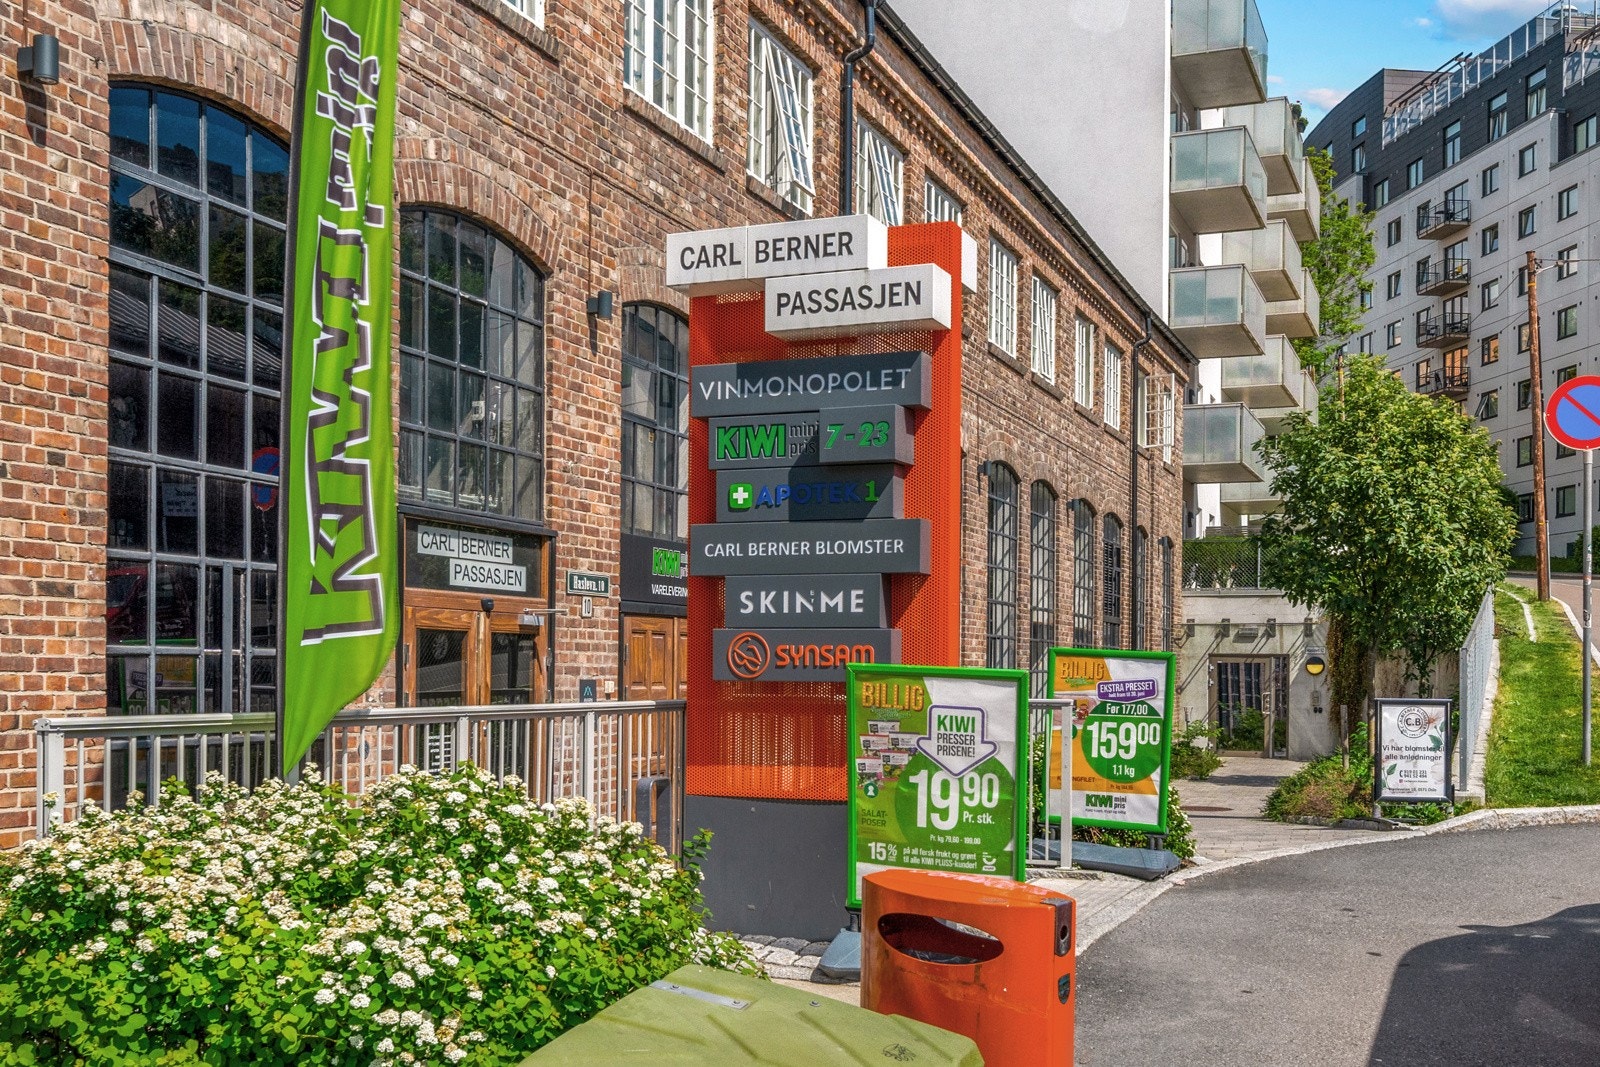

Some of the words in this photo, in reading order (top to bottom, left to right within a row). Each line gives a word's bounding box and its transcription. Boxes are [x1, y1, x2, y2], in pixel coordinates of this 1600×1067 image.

[680, 242, 741, 271] CARL
[755, 231, 854, 264] BERNER
[776, 280, 922, 317] PASSASJEN
[699, 368, 912, 401] VINMONOPOLET
[300, 214, 385, 646] KIWI
[788, 420, 819, 438] mini
[715, 422, 787, 461] KIWI
[788, 438, 816, 459] pris
[755, 482, 863, 508] APOTEK
[421, 531, 455, 552] CARL
[461, 537, 510, 560] BERNER
[704, 542, 743, 558] CARL
[749, 541, 810, 557] BERNER
[816, 538, 904, 556] BLOMSTER
[652, 546, 681, 578] KIWI
[454, 563, 522, 588] PASSASJEN
[598, 580, 605, 592] 10
[651, 583, 688, 598] VARELEVERIN
[584, 598, 591, 615] 10
[775, 643, 875, 668] SYNSAM
[1060, 661, 1105, 681] BILLIG
[1100, 683, 1125, 693] EKSTRA
[1125, 681, 1153, 691] PRESSET
[861, 681, 924, 712] BILLIG
[1106, 703, 1119, 714] Før
[1122, 704, 1148, 716] 177,00
[937, 714, 975, 734] KIWI
[1405, 717, 1421, 726] C.B
[937, 733, 975, 746] PRESSER
[937, 745, 975, 758] PRISENE!
[1400, 753, 1442, 763] anledninger
[1124, 764, 1135, 778] kg
[1085, 793, 1113, 808] KIWI
[861, 817, 887, 828] POSER
[962, 810, 975, 824] Pr.
[976, 812, 995, 825] stk.
[910, 856, 920, 865] alle
[921, 857, 934, 866] KIWI
[936, 849, 951, 858] frukt
[952, 852, 959, 861] og
